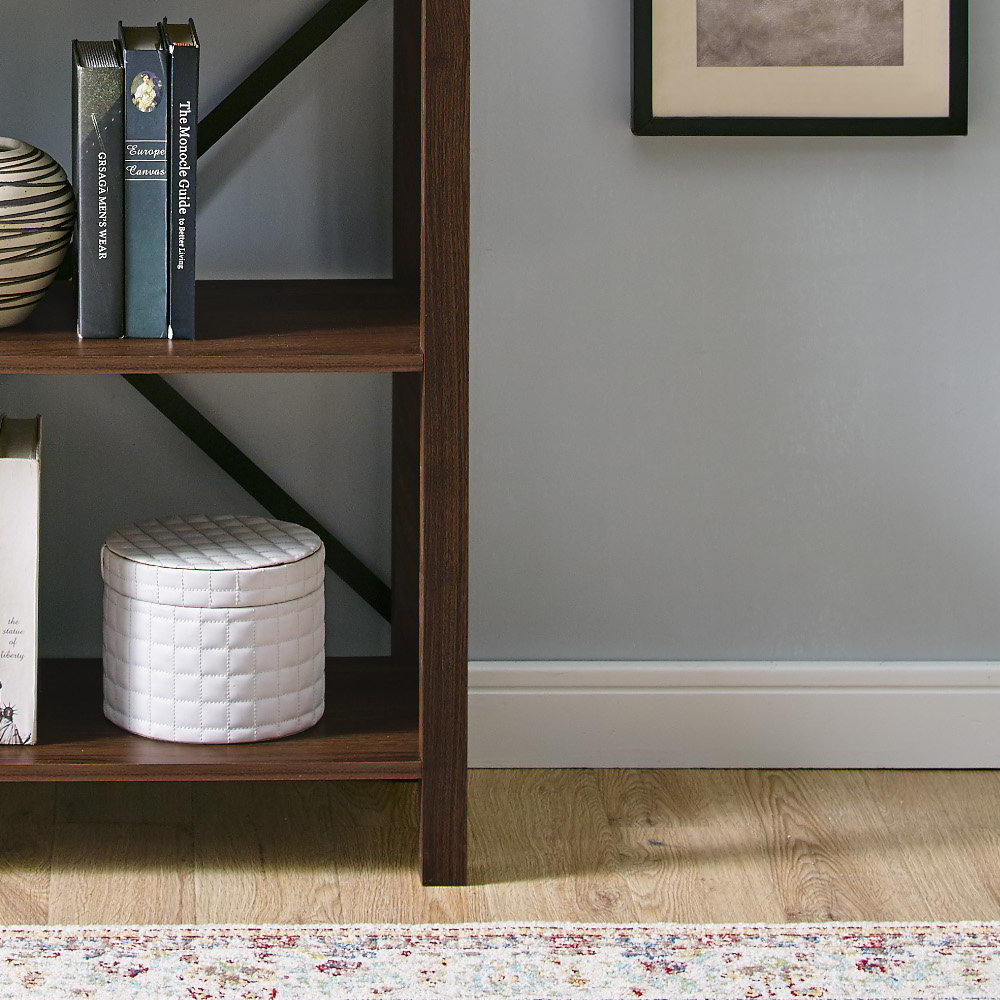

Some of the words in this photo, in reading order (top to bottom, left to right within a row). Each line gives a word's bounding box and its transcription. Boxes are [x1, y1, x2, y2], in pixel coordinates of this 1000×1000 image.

[178, 101, 191, 124] The
[126, 143, 166, 157] Europe
[178, 126, 191, 177] Monocle
[125, 164, 167, 176] Canvas
[178, 179, 191, 215] Guide
[98, 196, 108, 227] MEN'S
[178, 218, 186, 226] to
[98, 228, 108, 260] WEAR
[177, 226, 186, 248] Better
[176, 248, 185, 270] Living
[7, 617, 19, 625] the
[8, 638, 16, 648] of
[0, 650, 25, 661] liberty
